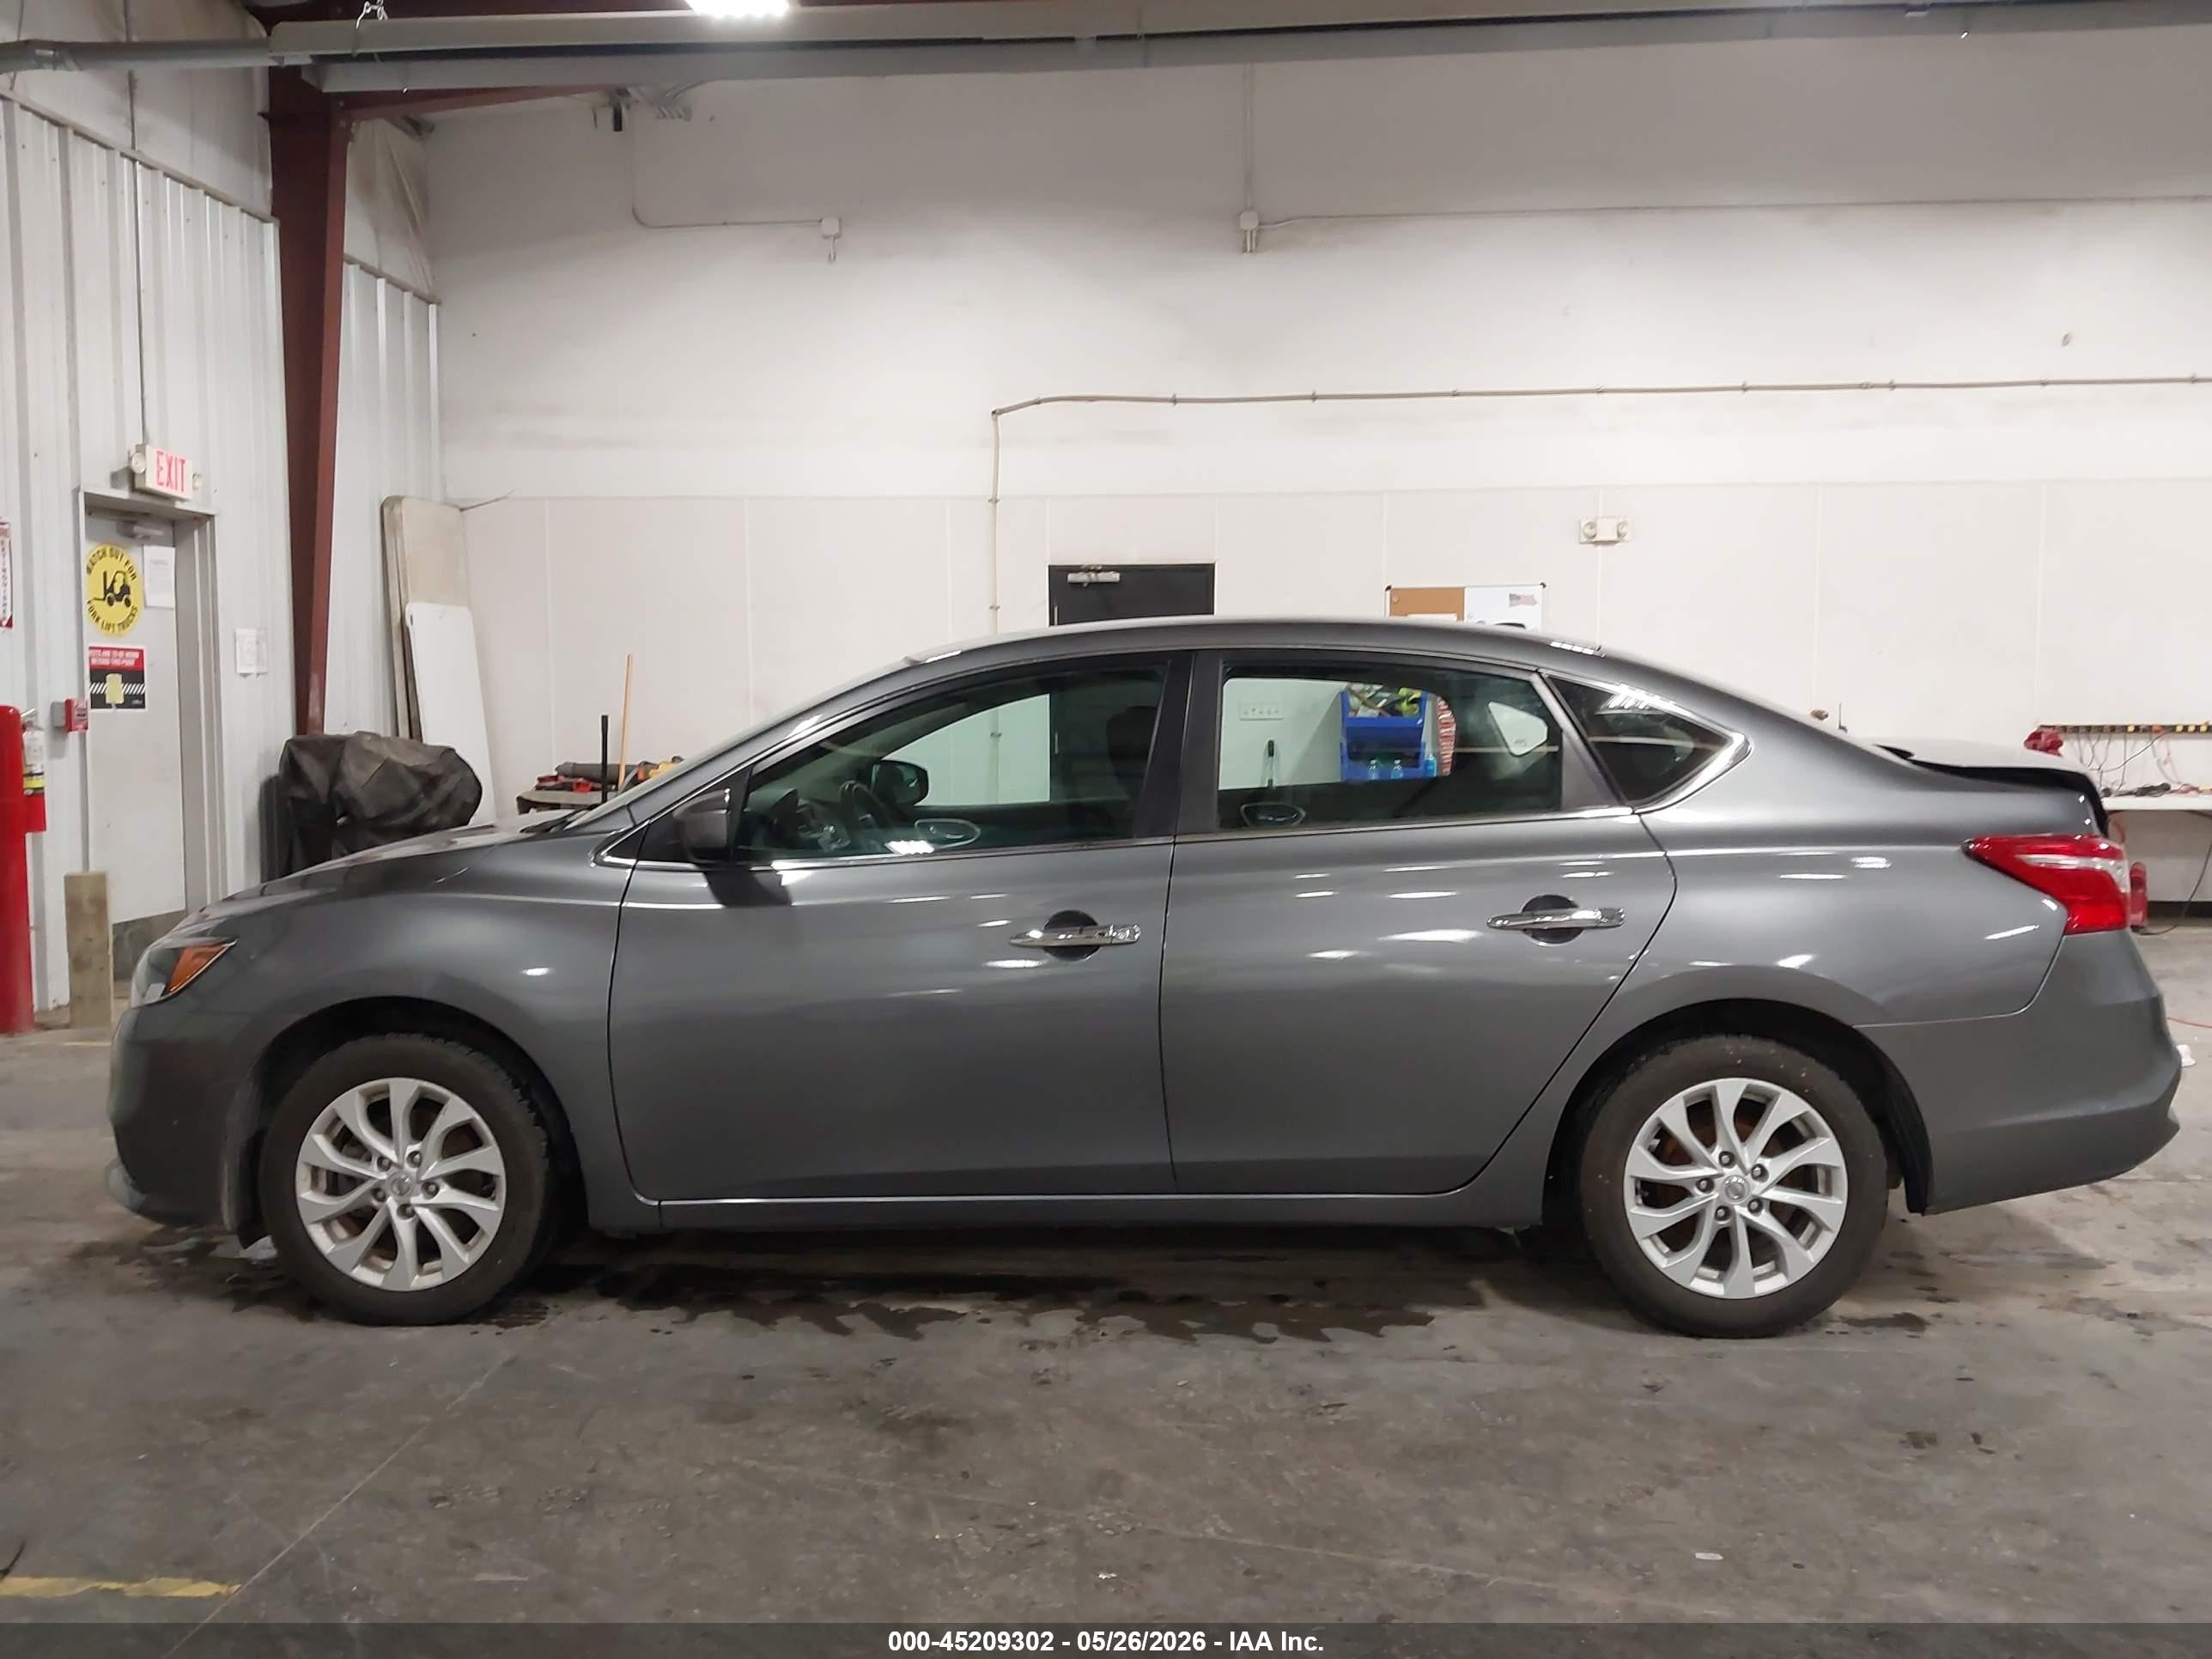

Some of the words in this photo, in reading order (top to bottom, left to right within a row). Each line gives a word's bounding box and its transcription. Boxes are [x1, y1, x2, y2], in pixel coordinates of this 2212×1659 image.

[155, 450, 186, 494] EXIT
[109, 547, 125, 562] OUT
[124, 559, 137, 581] FOR
